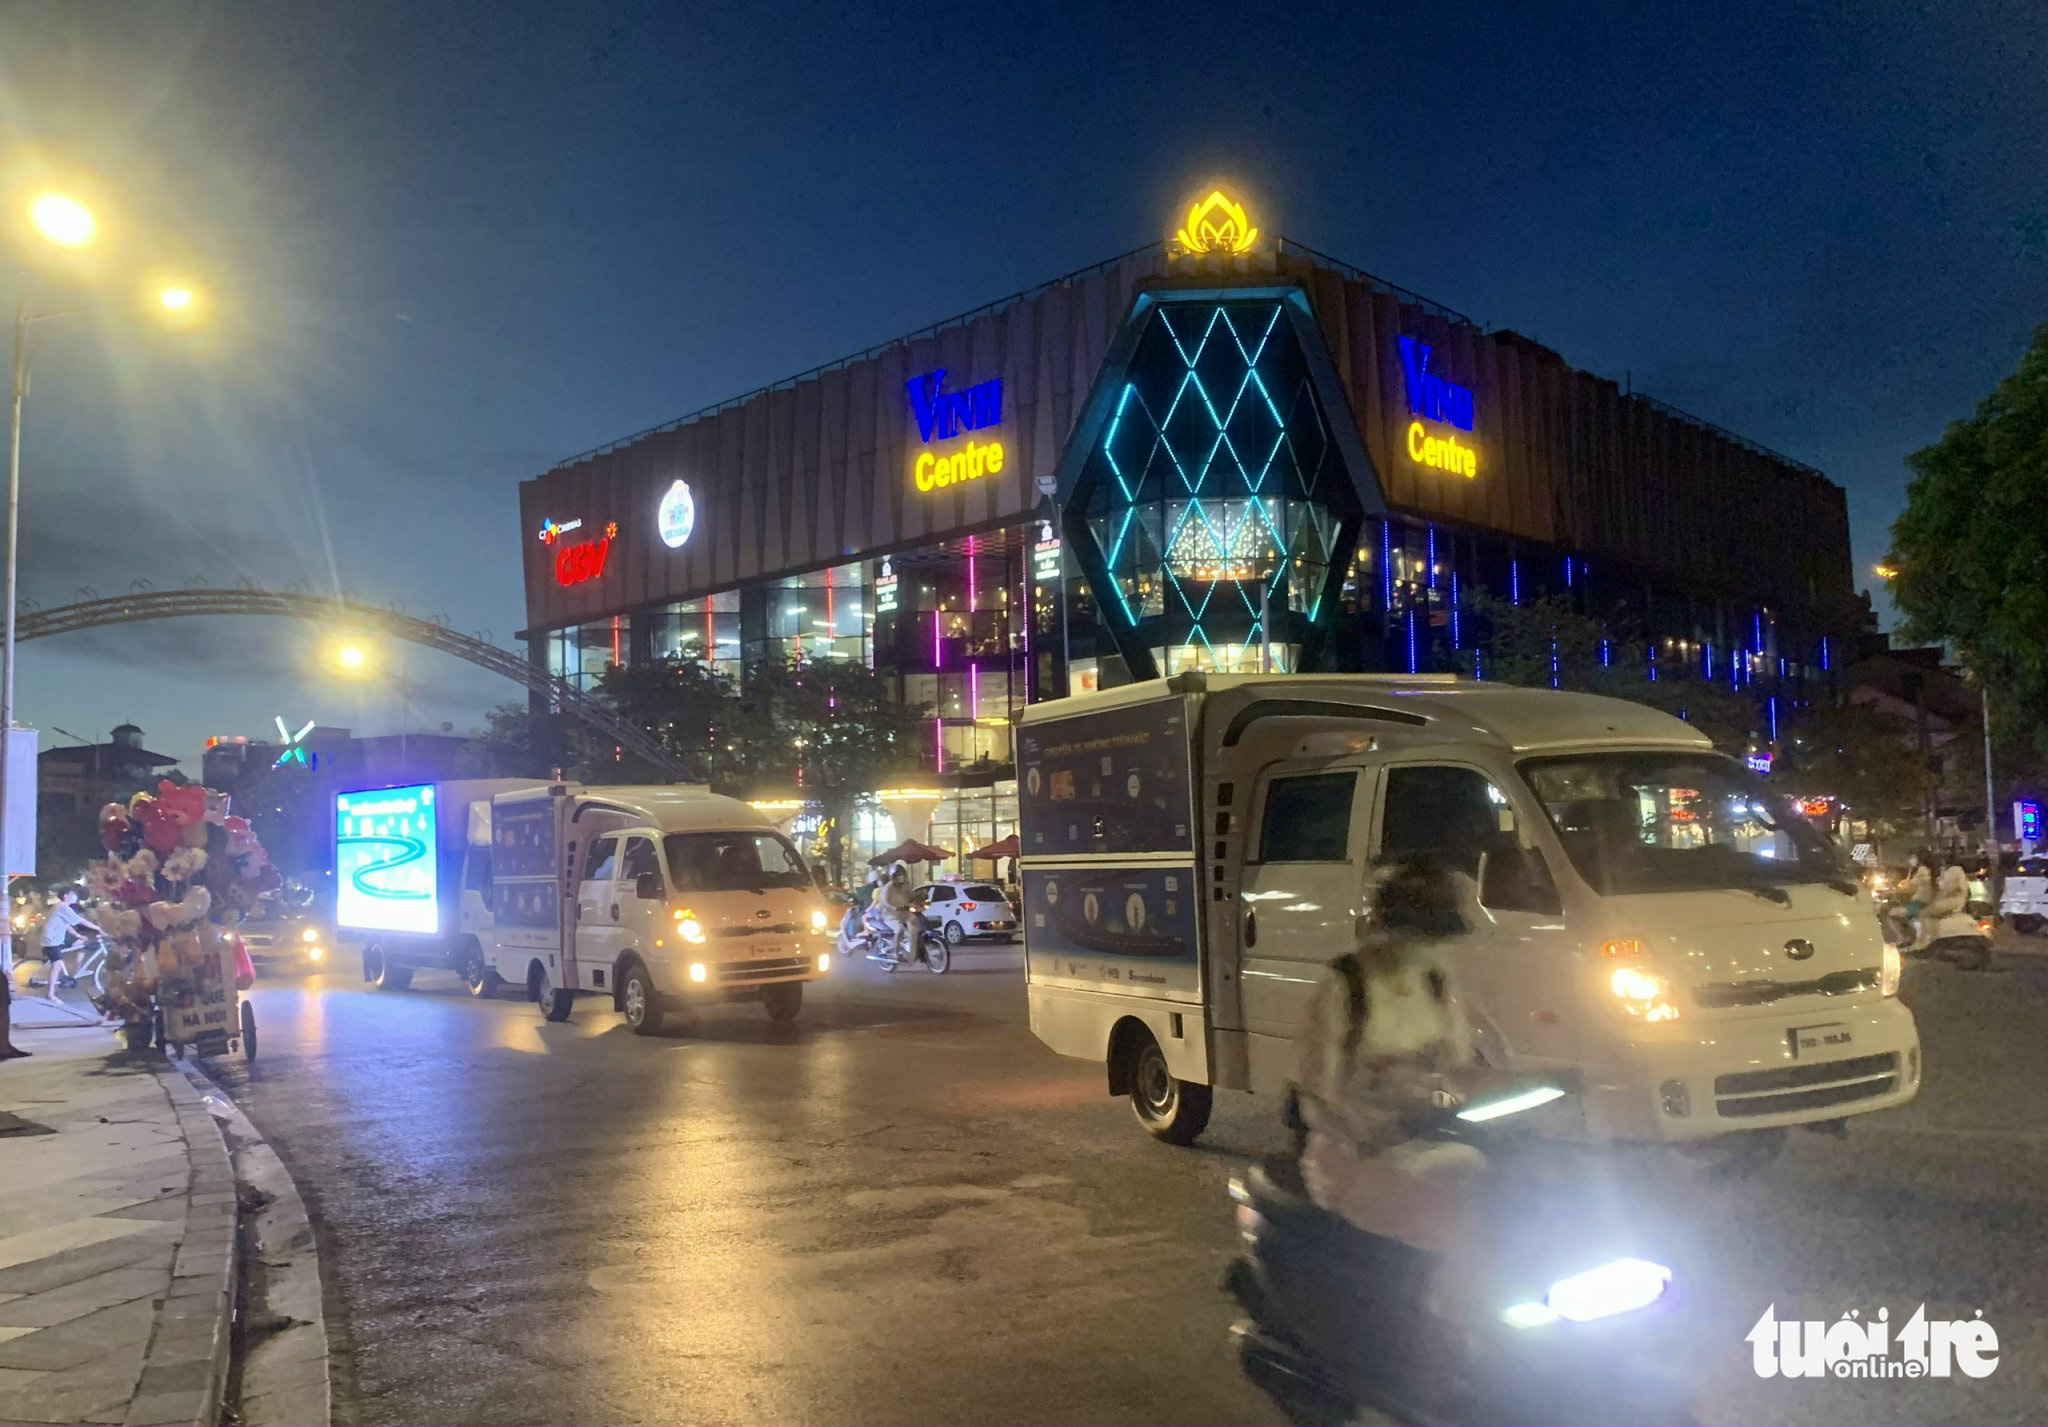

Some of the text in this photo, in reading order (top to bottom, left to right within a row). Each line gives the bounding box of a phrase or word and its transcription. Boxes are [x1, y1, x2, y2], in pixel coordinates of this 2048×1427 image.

[915, 440, 1004, 492] Centre
[1408, 421, 1477, 479] Centre
[556, 538, 608, 587] CGV
